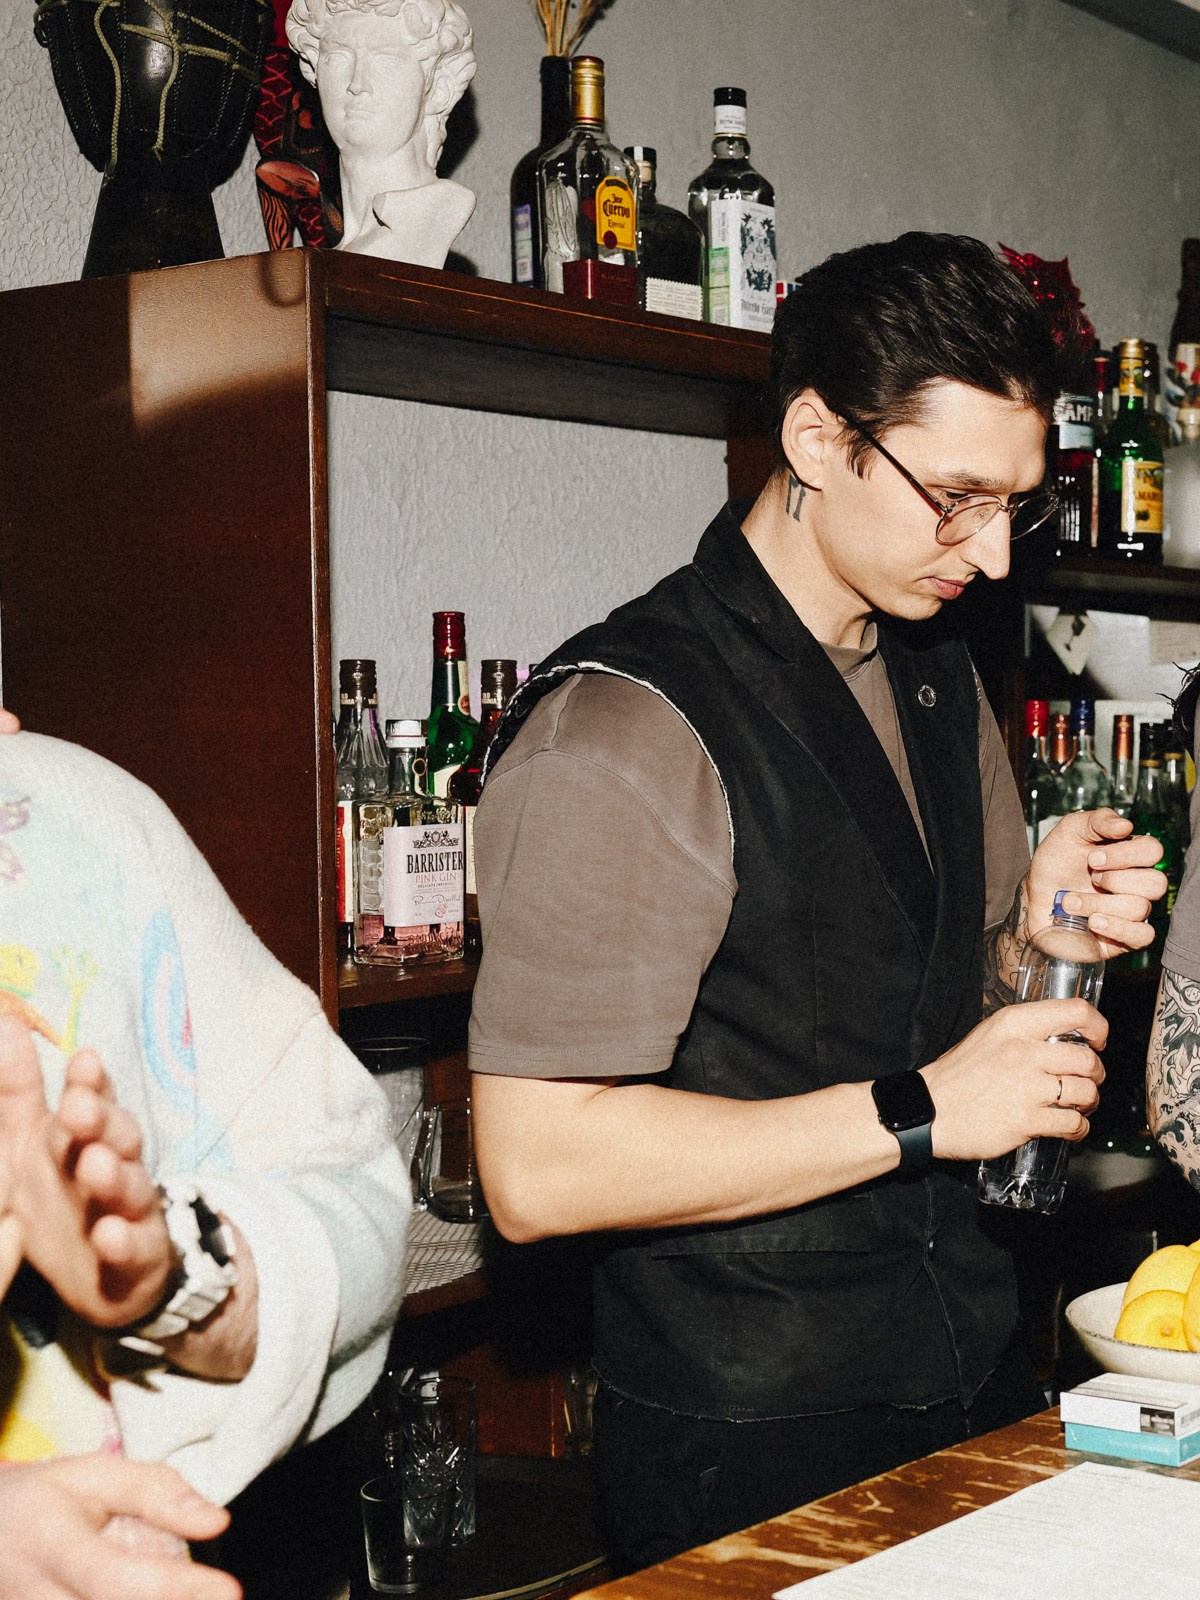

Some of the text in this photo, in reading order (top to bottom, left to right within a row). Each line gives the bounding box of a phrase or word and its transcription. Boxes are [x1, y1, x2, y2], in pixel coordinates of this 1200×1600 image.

[602, 199, 631, 219] Cuervo
[406, 851, 464, 874] BARRISTER
[415, 872, 457, 884] PINK GIN
